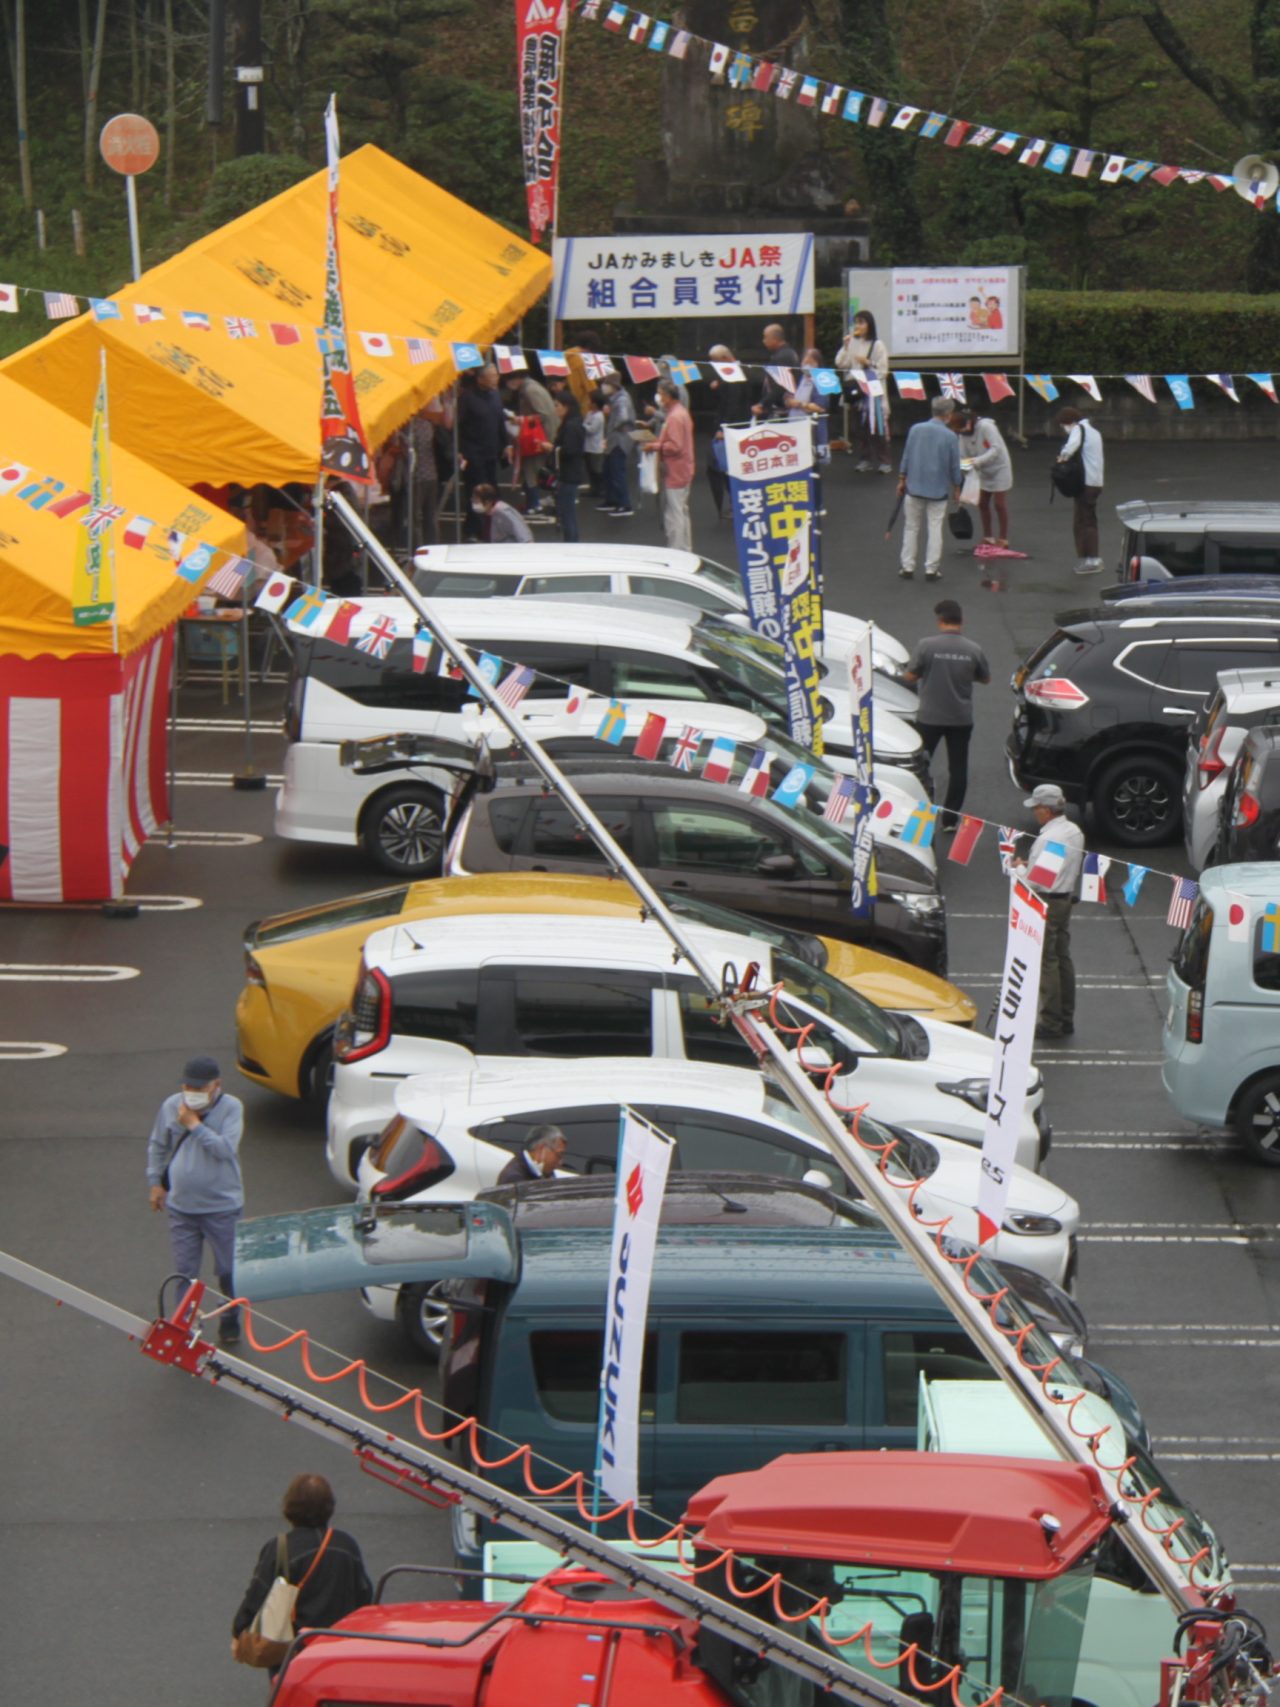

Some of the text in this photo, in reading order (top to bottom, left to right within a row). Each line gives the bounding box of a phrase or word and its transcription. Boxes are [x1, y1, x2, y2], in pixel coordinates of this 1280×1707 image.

[588, 244, 782, 270] JAかみましきJA祭
[587, 274, 784, 309] 組合員受付
